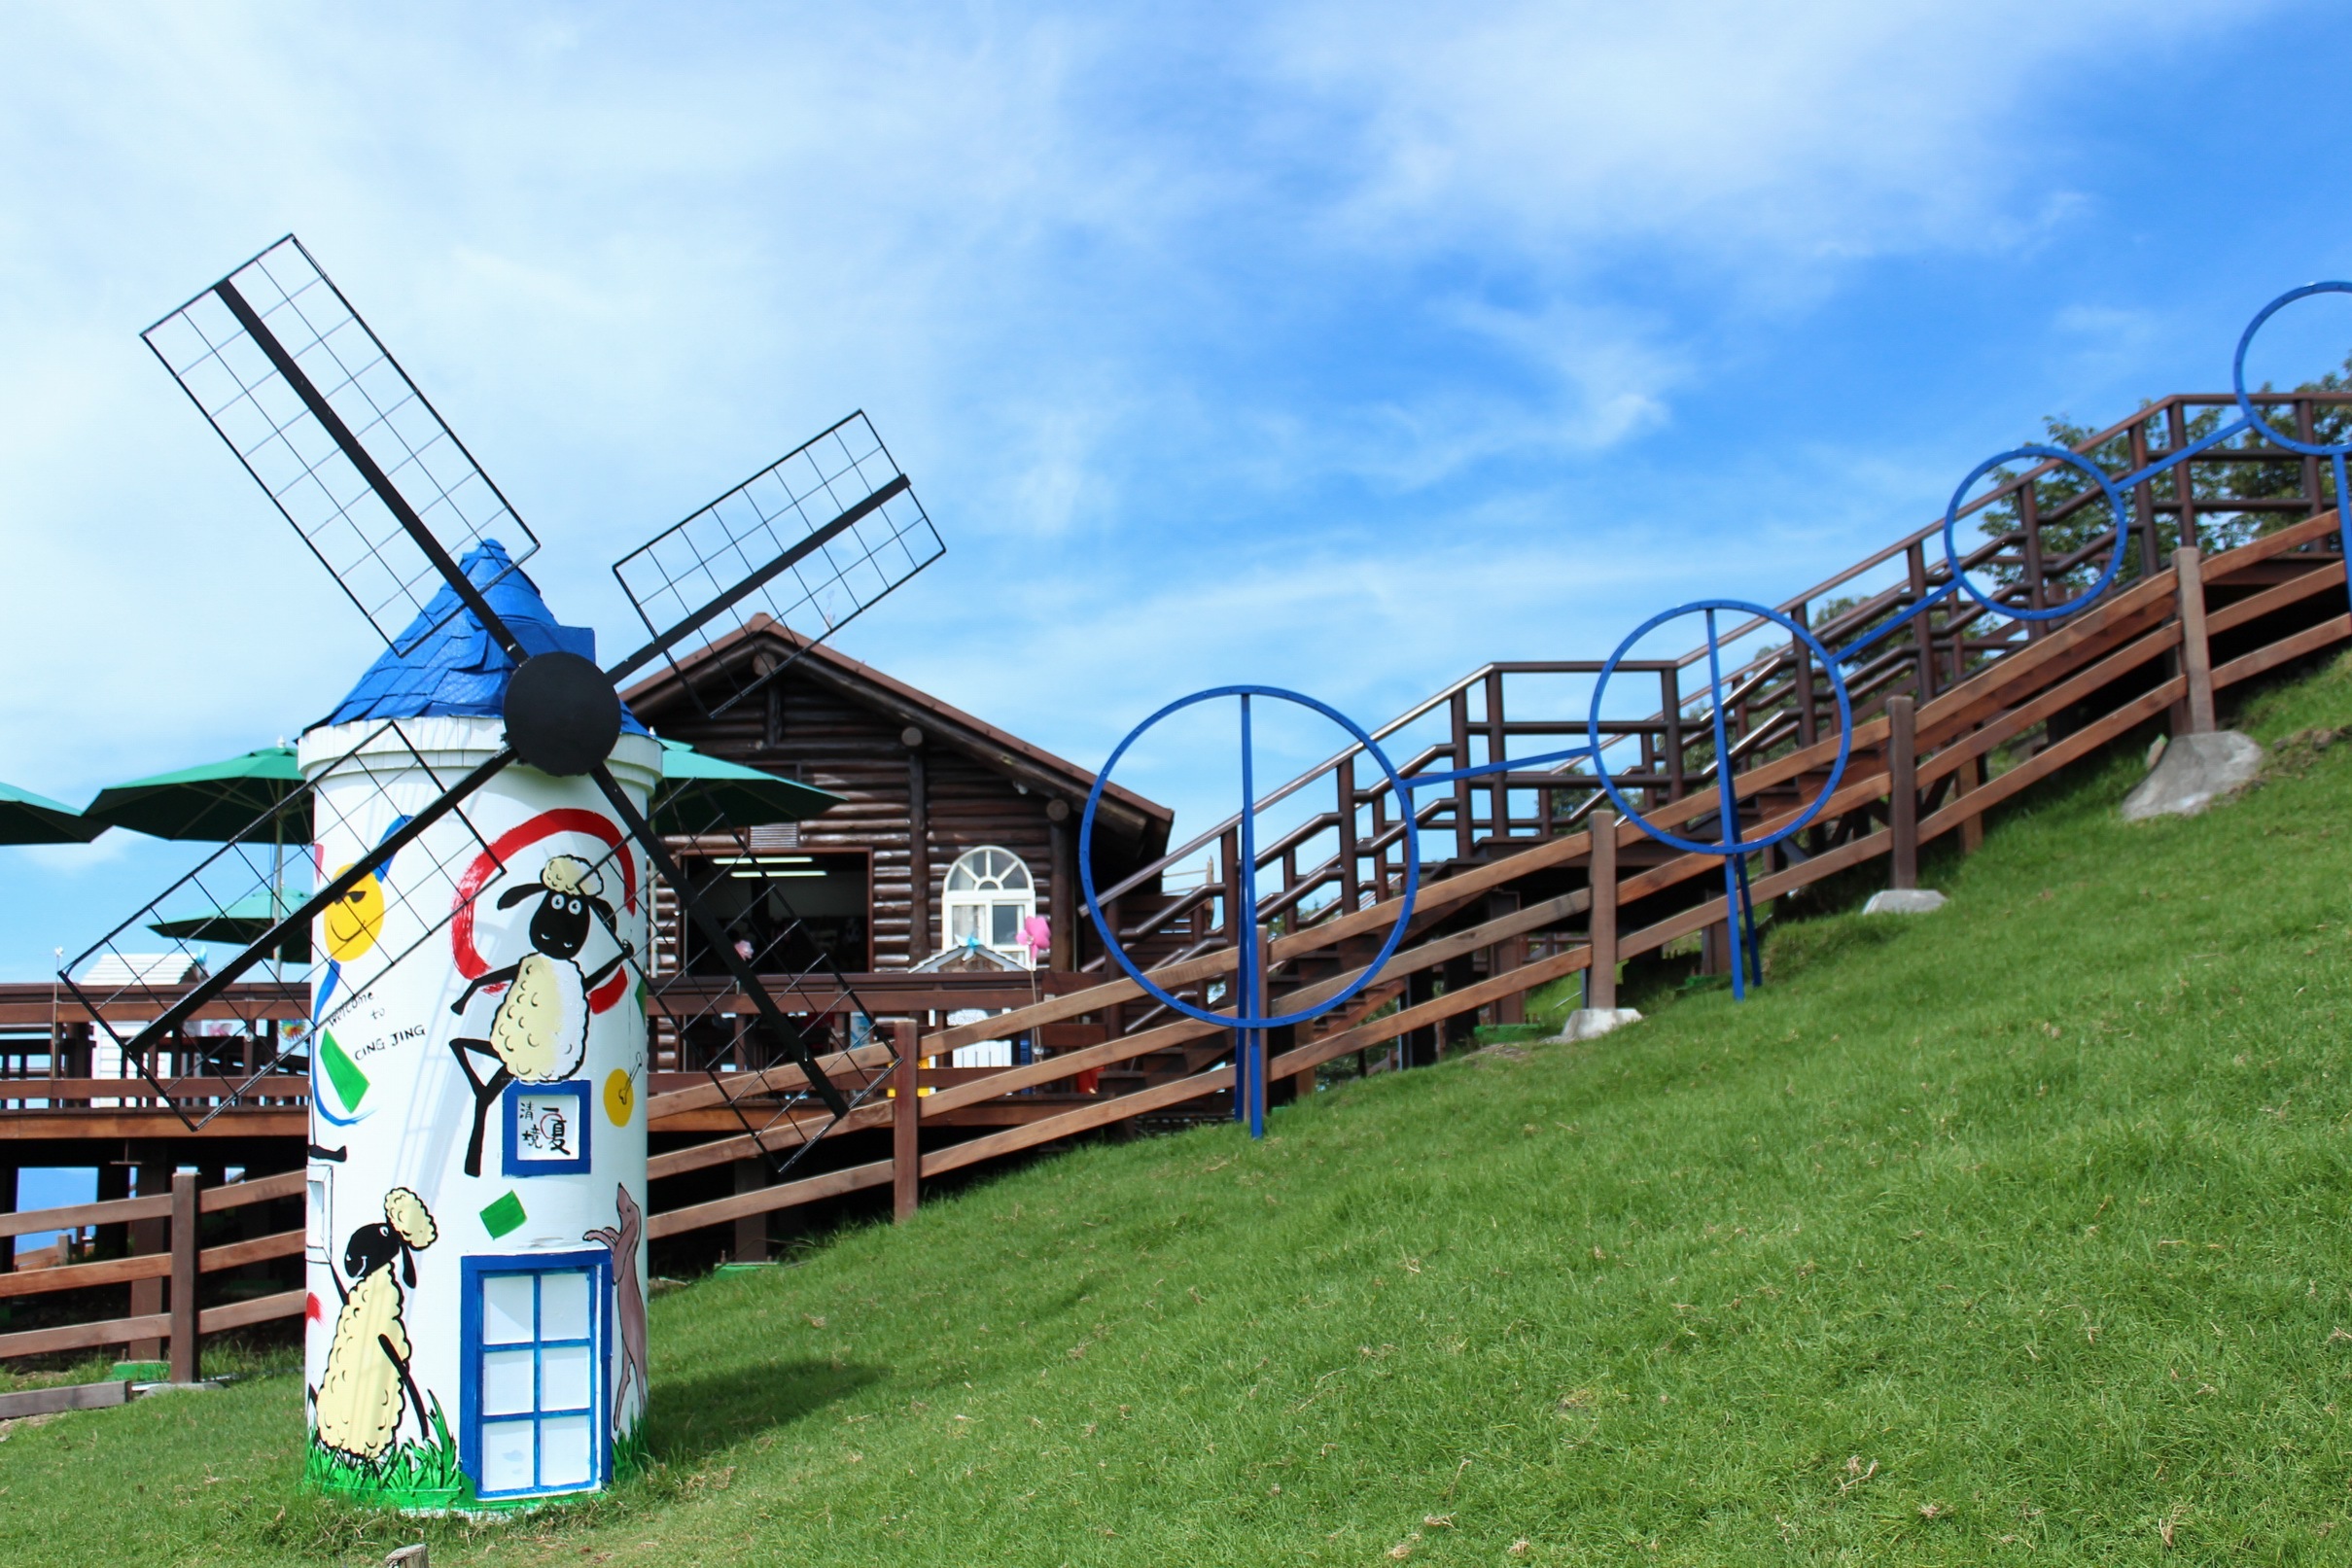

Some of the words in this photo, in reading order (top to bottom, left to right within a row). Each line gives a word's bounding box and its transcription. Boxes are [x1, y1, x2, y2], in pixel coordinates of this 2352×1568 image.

[370, 1007, 386, 1021] to
[354, 1038, 386, 1062] CING
[390, 1024, 426, 1047] JING
